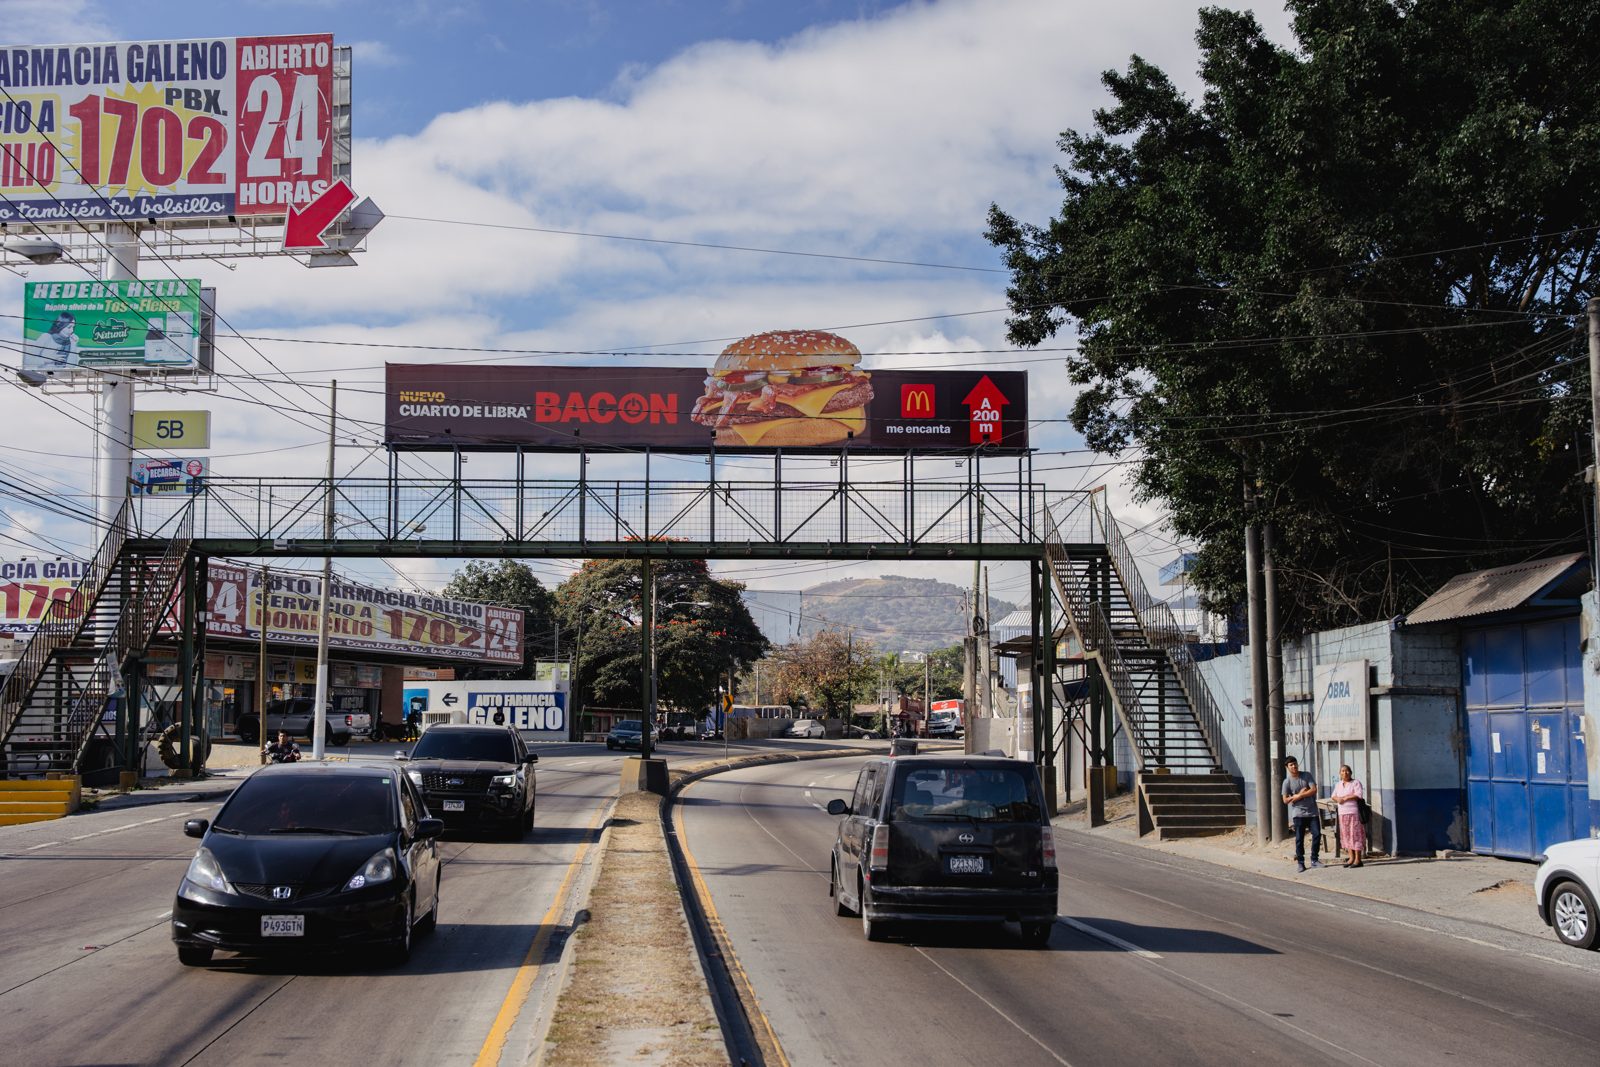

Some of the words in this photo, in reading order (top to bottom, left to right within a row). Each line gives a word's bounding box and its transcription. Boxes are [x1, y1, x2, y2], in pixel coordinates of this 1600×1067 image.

[127, 41, 227, 82] GALENO
[240, 42, 329, 70] ABIERTO
[165, 87, 228, 116] PBX.
[0, 100, 32, 134] IO
[37, 100, 54, 132] A
[246, 74, 322, 178] 24
[69, 93, 228, 187] 1702
[240, 180, 328, 205] HORAS
[16, 200, 107, 219] también
[109, 198, 136, 215] tu
[140, 196, 225, 215] bolsillo
[33, 282, 120, 299] HEDERA
[127, 281, 190, 297] HELIX
[104, 300, 128, 313] Tos
[399, 391, 445, 403] NUEVO
[981, 398, 991, 409] A
[399, 404, 460, 417] CUARTO
[463, 405, 481, 418] DE
[535, 391, 678, 424] BACON
[972, 410, 999, 421] 200
[157, 420, 184, 439] 5B
[886, 426, 903, 434] me
[905, 424, 950, 434] encanta
[979, 423, 993, 433] m
[251, 572, 311, 595] AUTO
[421, 598, 482, 618] GALENO
[360, 606, 372, 619] A
[487, 609, 521, 621] ABIERTO
[206, 622, 242, 634] RAS
[382, 609, 482, 649] 1702
[489, 619, 519, 651] 24
[487, 650, 520, 661] HORAS
[1327, 681, 1350, 699] OBRA
[476, 694, 503, 706] AUTO
[504, 694, 556, 706] FARMACIA
[468, 706, 563, 730] GALENO
[263, 920, 303, 932] P493GTN
